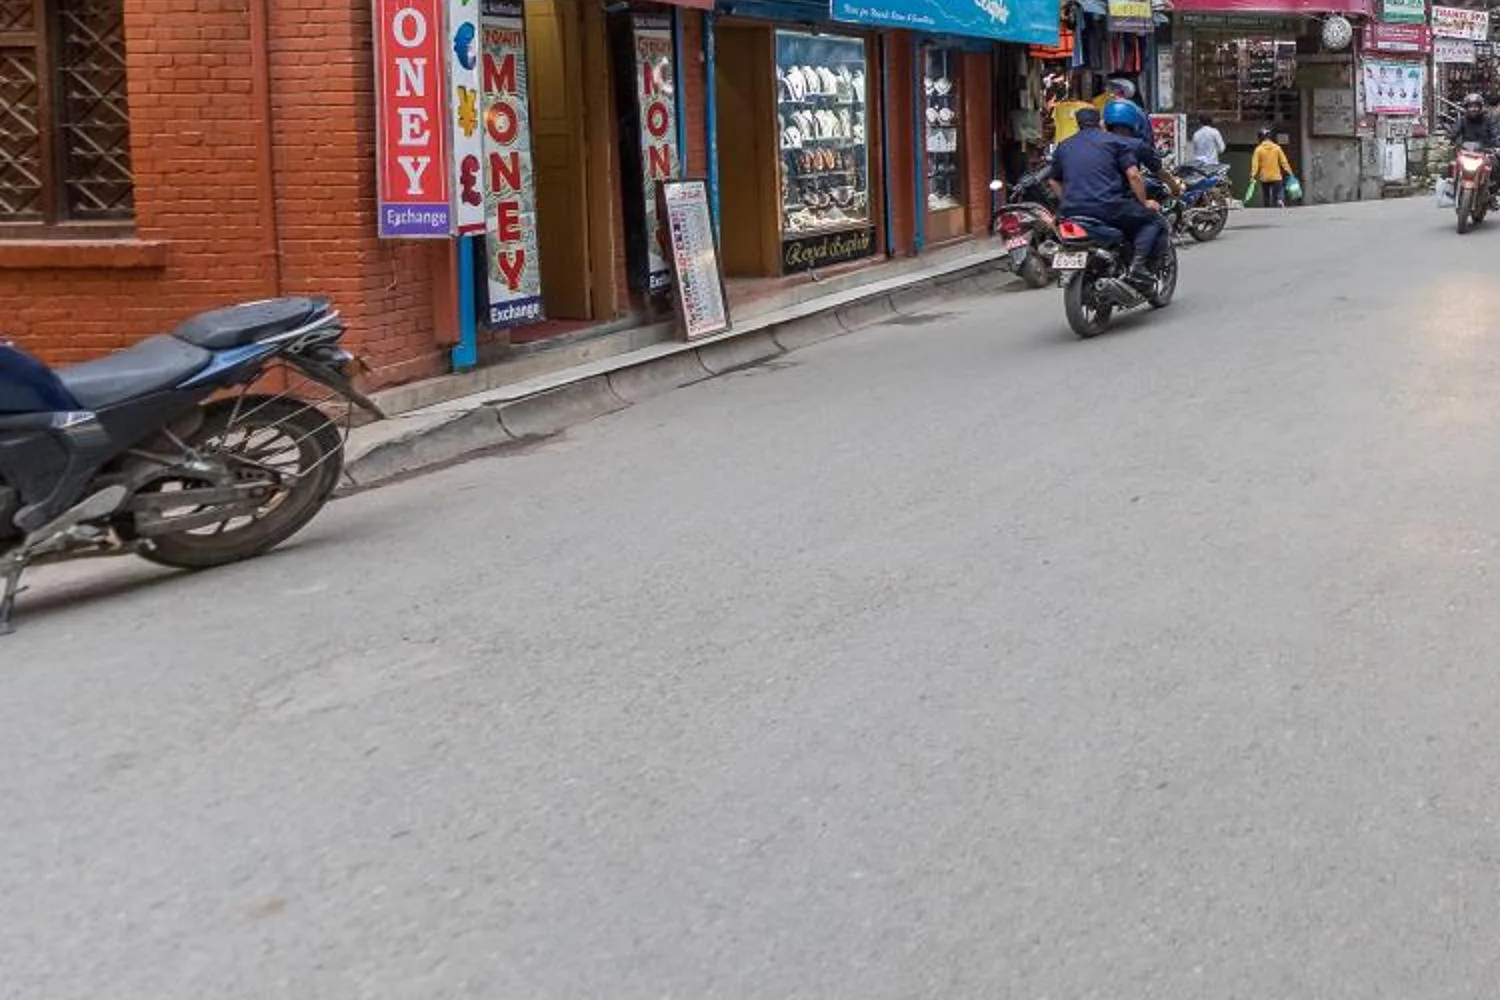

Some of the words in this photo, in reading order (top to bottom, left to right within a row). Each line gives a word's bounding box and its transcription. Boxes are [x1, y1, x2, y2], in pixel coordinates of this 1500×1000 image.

[481, 52, 526, 291] MONEY
[387, 208, 447, 227] Exchange
[490, 303, 540, 324] Exchange
